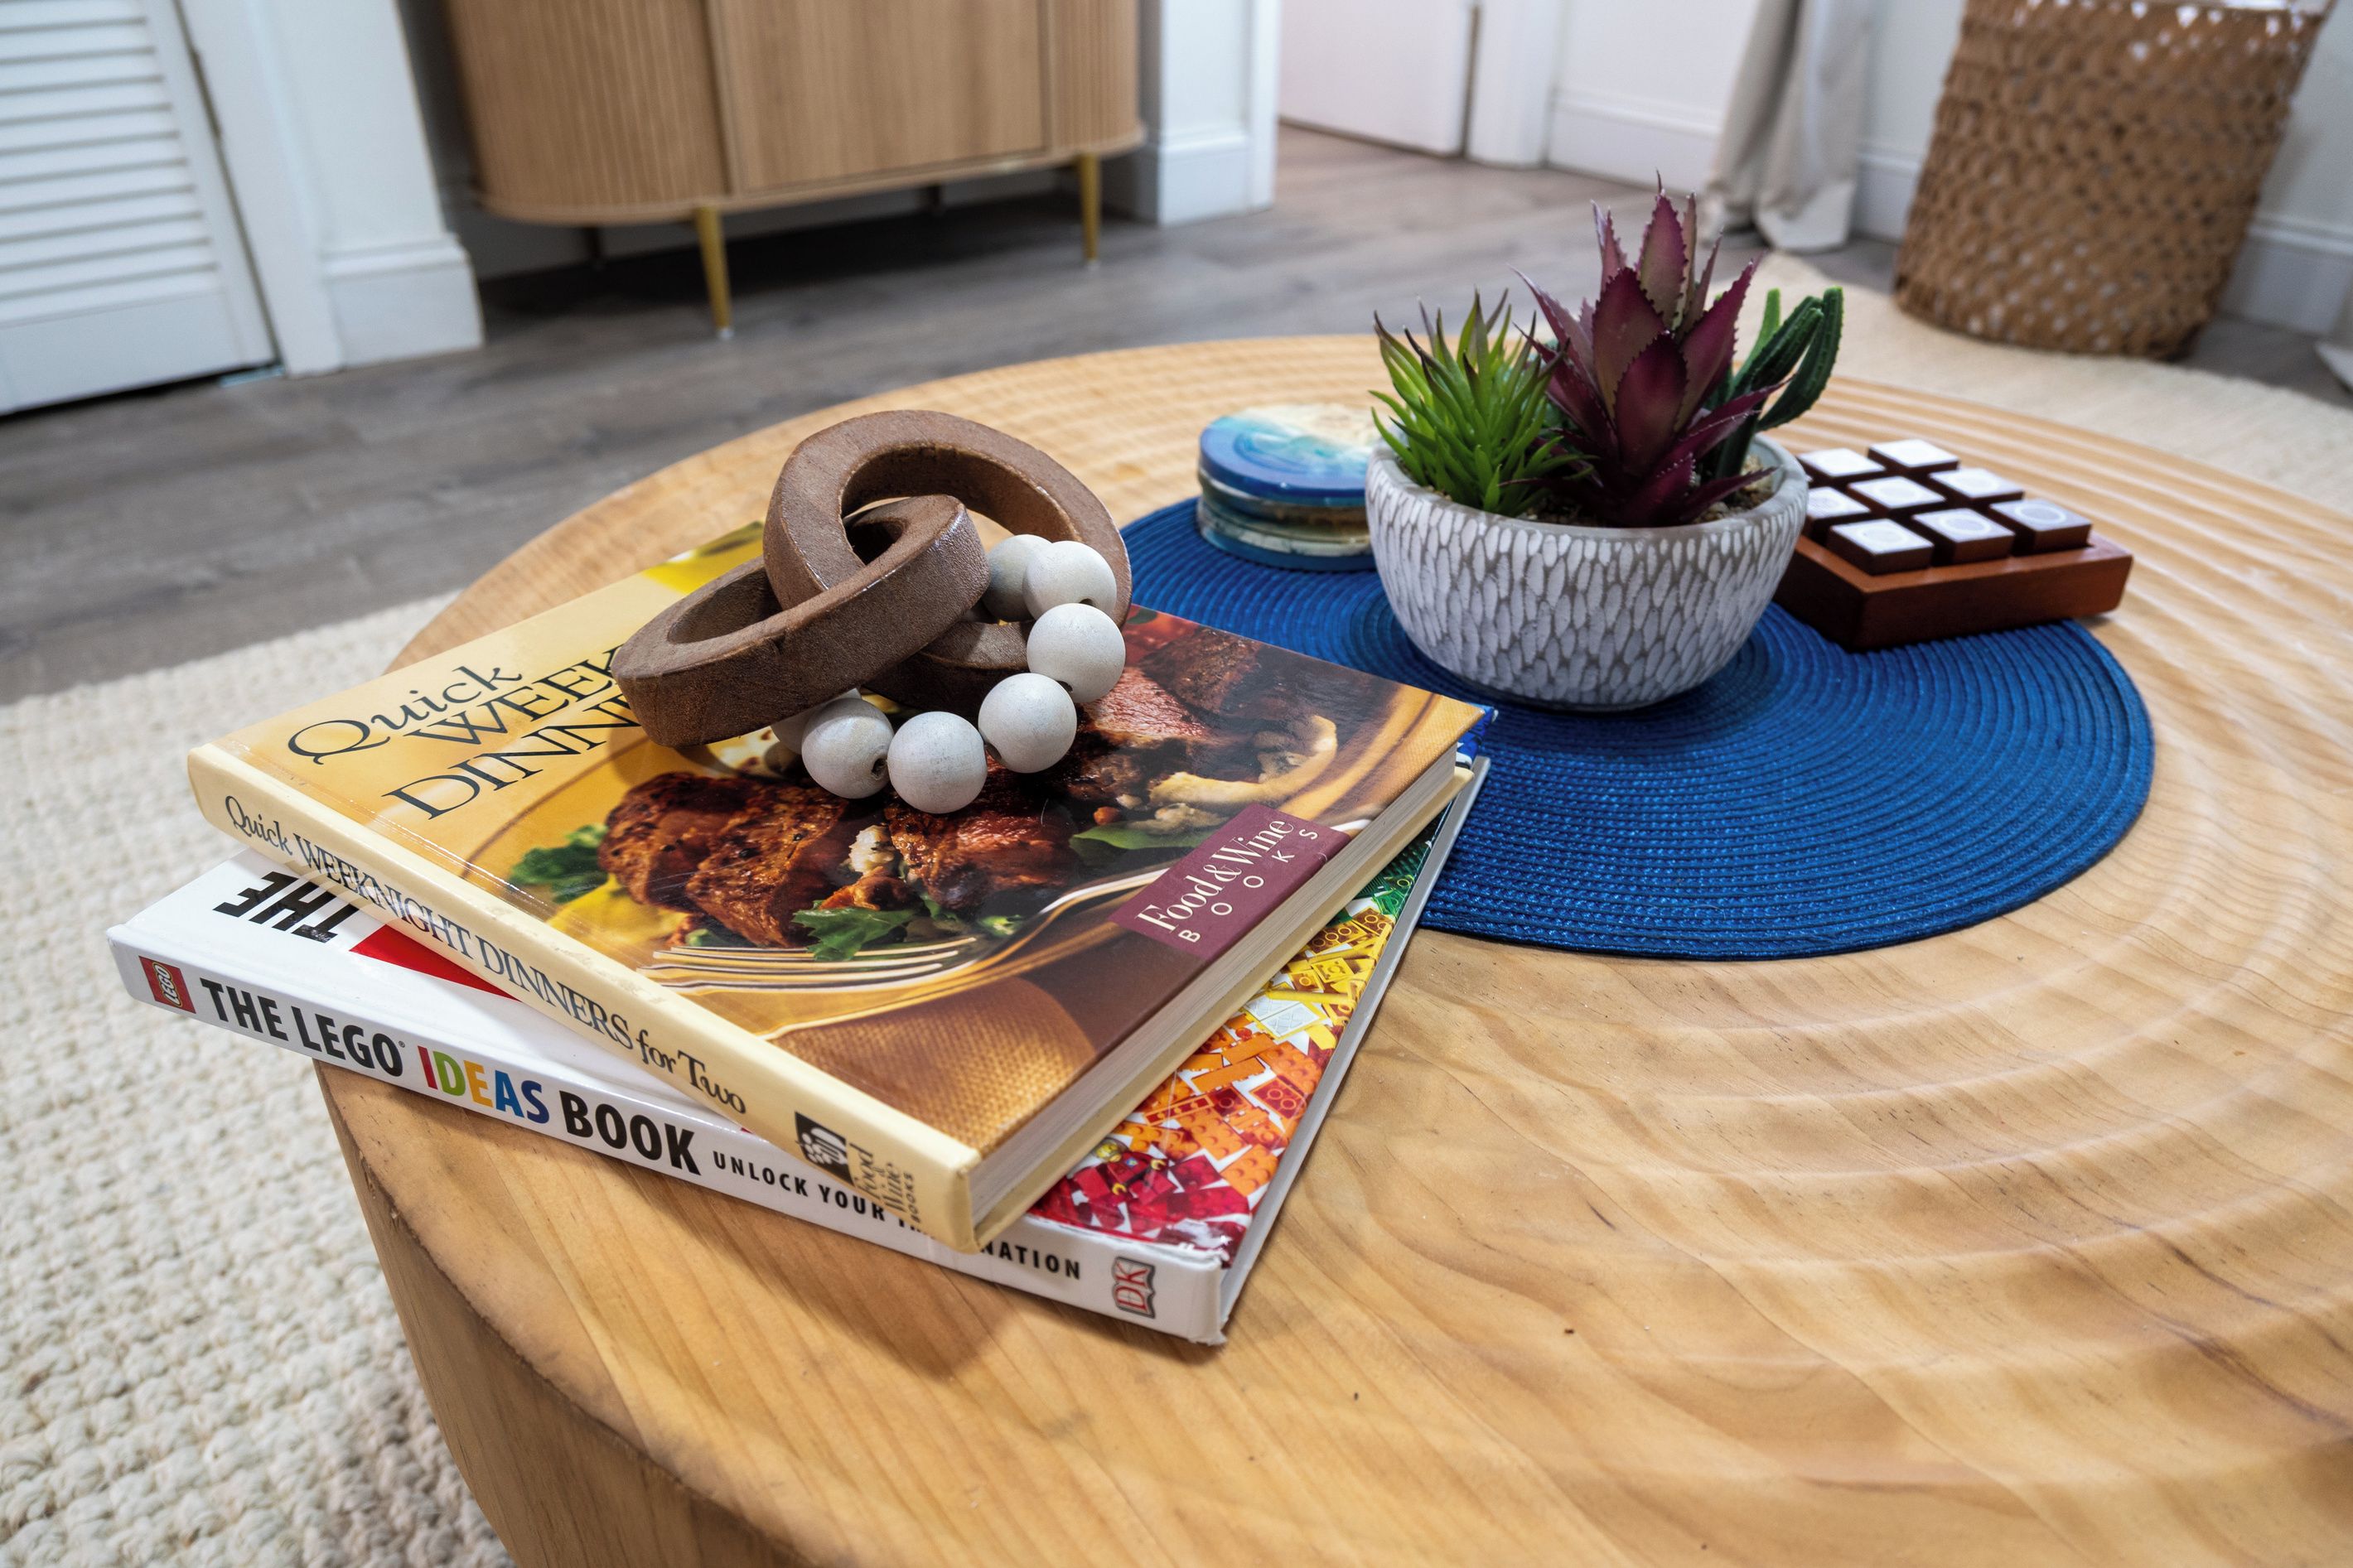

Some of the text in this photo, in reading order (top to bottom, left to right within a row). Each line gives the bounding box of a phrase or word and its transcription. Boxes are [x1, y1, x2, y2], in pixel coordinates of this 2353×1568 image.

[287, 665, 522, 765] Quick
[212, 871, 360, 943] THE
[1135, 875, 1225, 934] Food
[1211, 819, 1294, 865] Wine
[1177, 828, 1319, 943] BOOKS
[152, 963, 182, 1006] LEGO
[225, 795, 746, 1114] Quick WEEKNIGHT DINNERS for Two
[199, 977, 288, 1042] THE
[418, 1045, 550, 1124] IDEAS
[558, 1089, 702, 1177] BOOK
[713, 1151, 809, 1198] UNLOCK
[818, 1183, 886, 1222] YOUR
[1114, 1261, 1150, 1314] DK
